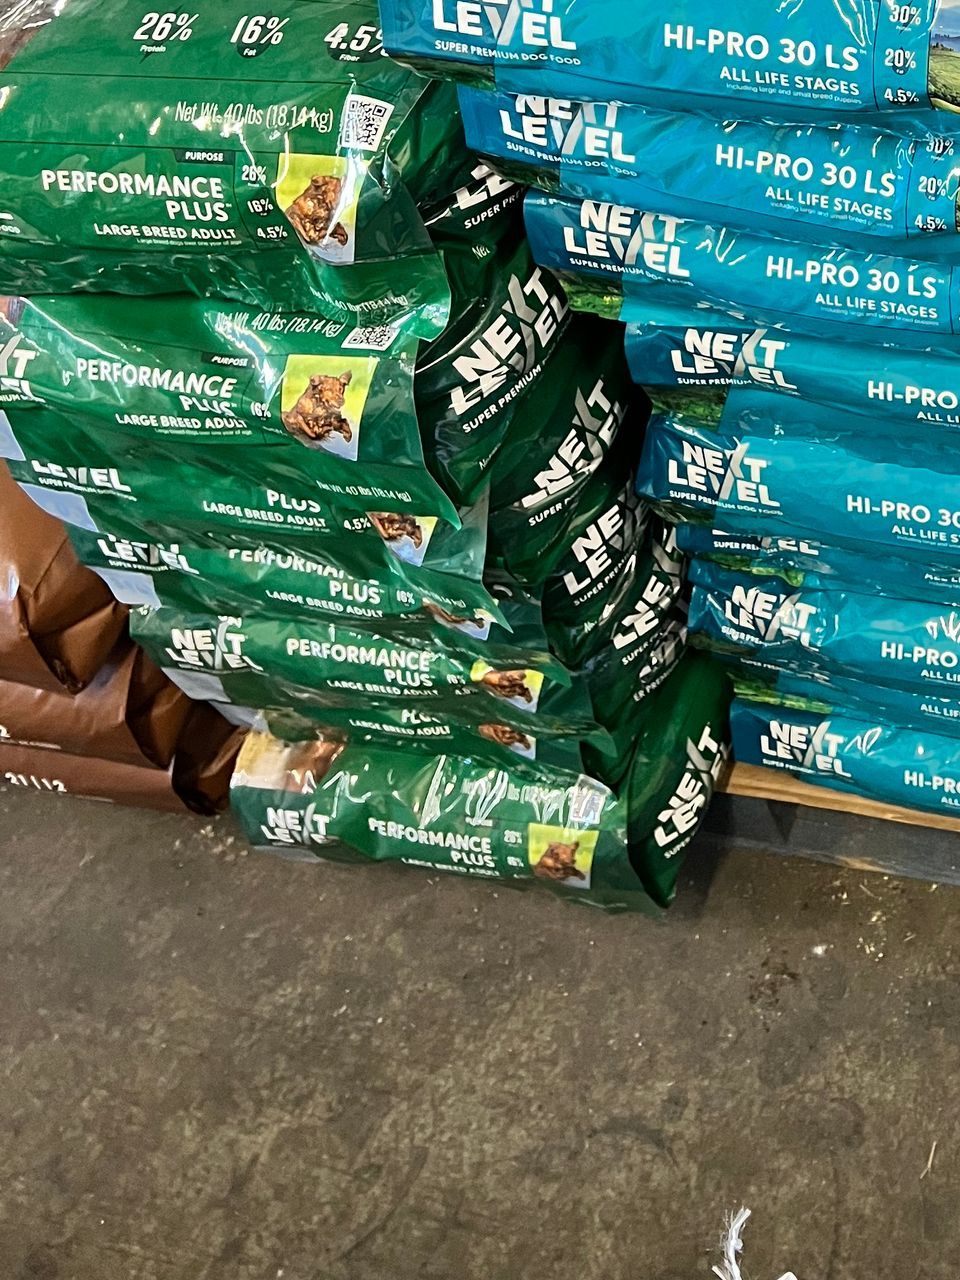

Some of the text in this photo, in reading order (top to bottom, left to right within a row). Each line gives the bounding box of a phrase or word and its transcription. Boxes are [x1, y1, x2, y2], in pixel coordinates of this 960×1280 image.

[133, 11, 199, 42] 26%
[230, 14, 290, 46] 16%
[888, 3, 921, 26] 30%
[434, 39, 520, 61] SUPER PREMIUM
[663, 22, 769, 61] HI-PRO
[777, 38, 817, 67] 30
[884, 47, 917, 70] 20%
[719, 66, 860, 96] ALL LIFE STAGES
[499, 109, 636, 164] LEVEL
[184, 151, 224, 162] PURPOSE
[715, 143, 857, 190] HI-PRO 30
[41, 169, 225, 200] PERFORMANCE
[166, 199, 230, 223] PLUS
[247, 197, 274, 214] 16%
[93, 222, 237, 241] LARGE BREED ADULT
[765, 255, 900, 294] HI-PRO 30
[452, 266, 549, 384] NEXT
[75, 356, 238, 400] PERFORMANCE
[115, 413, 248, 430] LARGE BREED ADULT
[286, 637, 430, 672] PERFORMANCE
[367, 817, 492, 854] PERFORMANCE
